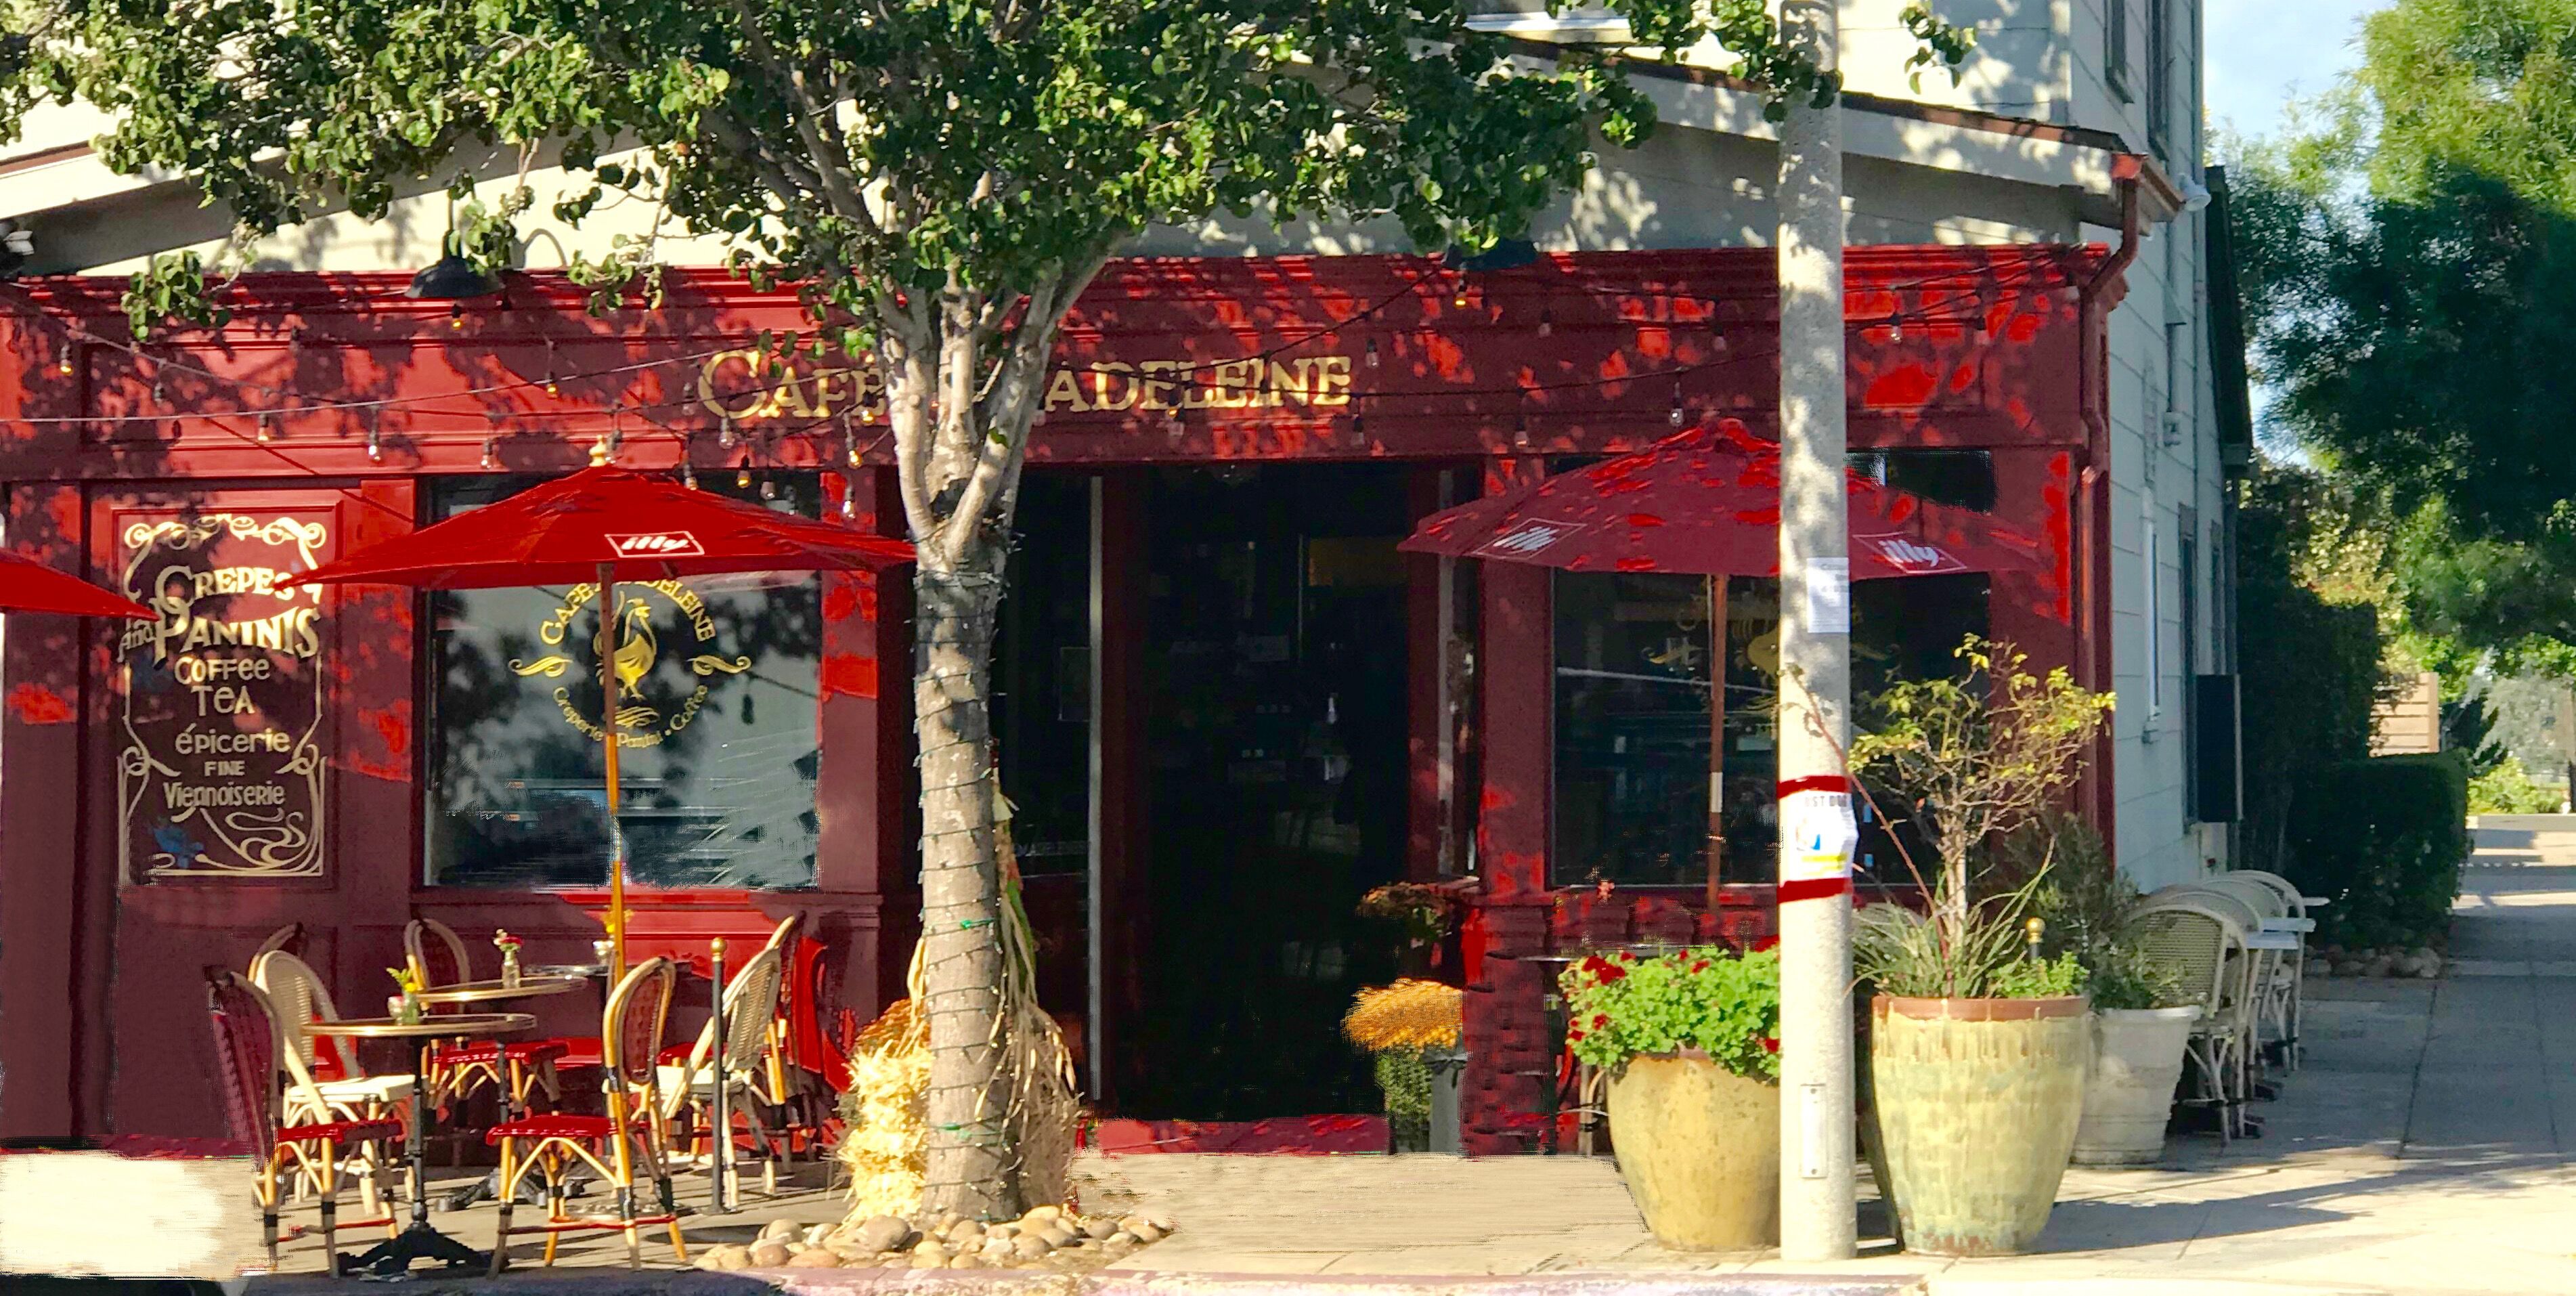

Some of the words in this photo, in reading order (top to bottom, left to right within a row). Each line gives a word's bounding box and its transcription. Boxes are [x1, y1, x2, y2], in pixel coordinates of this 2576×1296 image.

[1045, 356, 1351, 412] ADELEINE
[621, 536, 691, 553] illy
[1877, 539, 1946, 567] illy
[175, 722, 291, 754] épicerie
[204, 760, 246, 777] FINE
